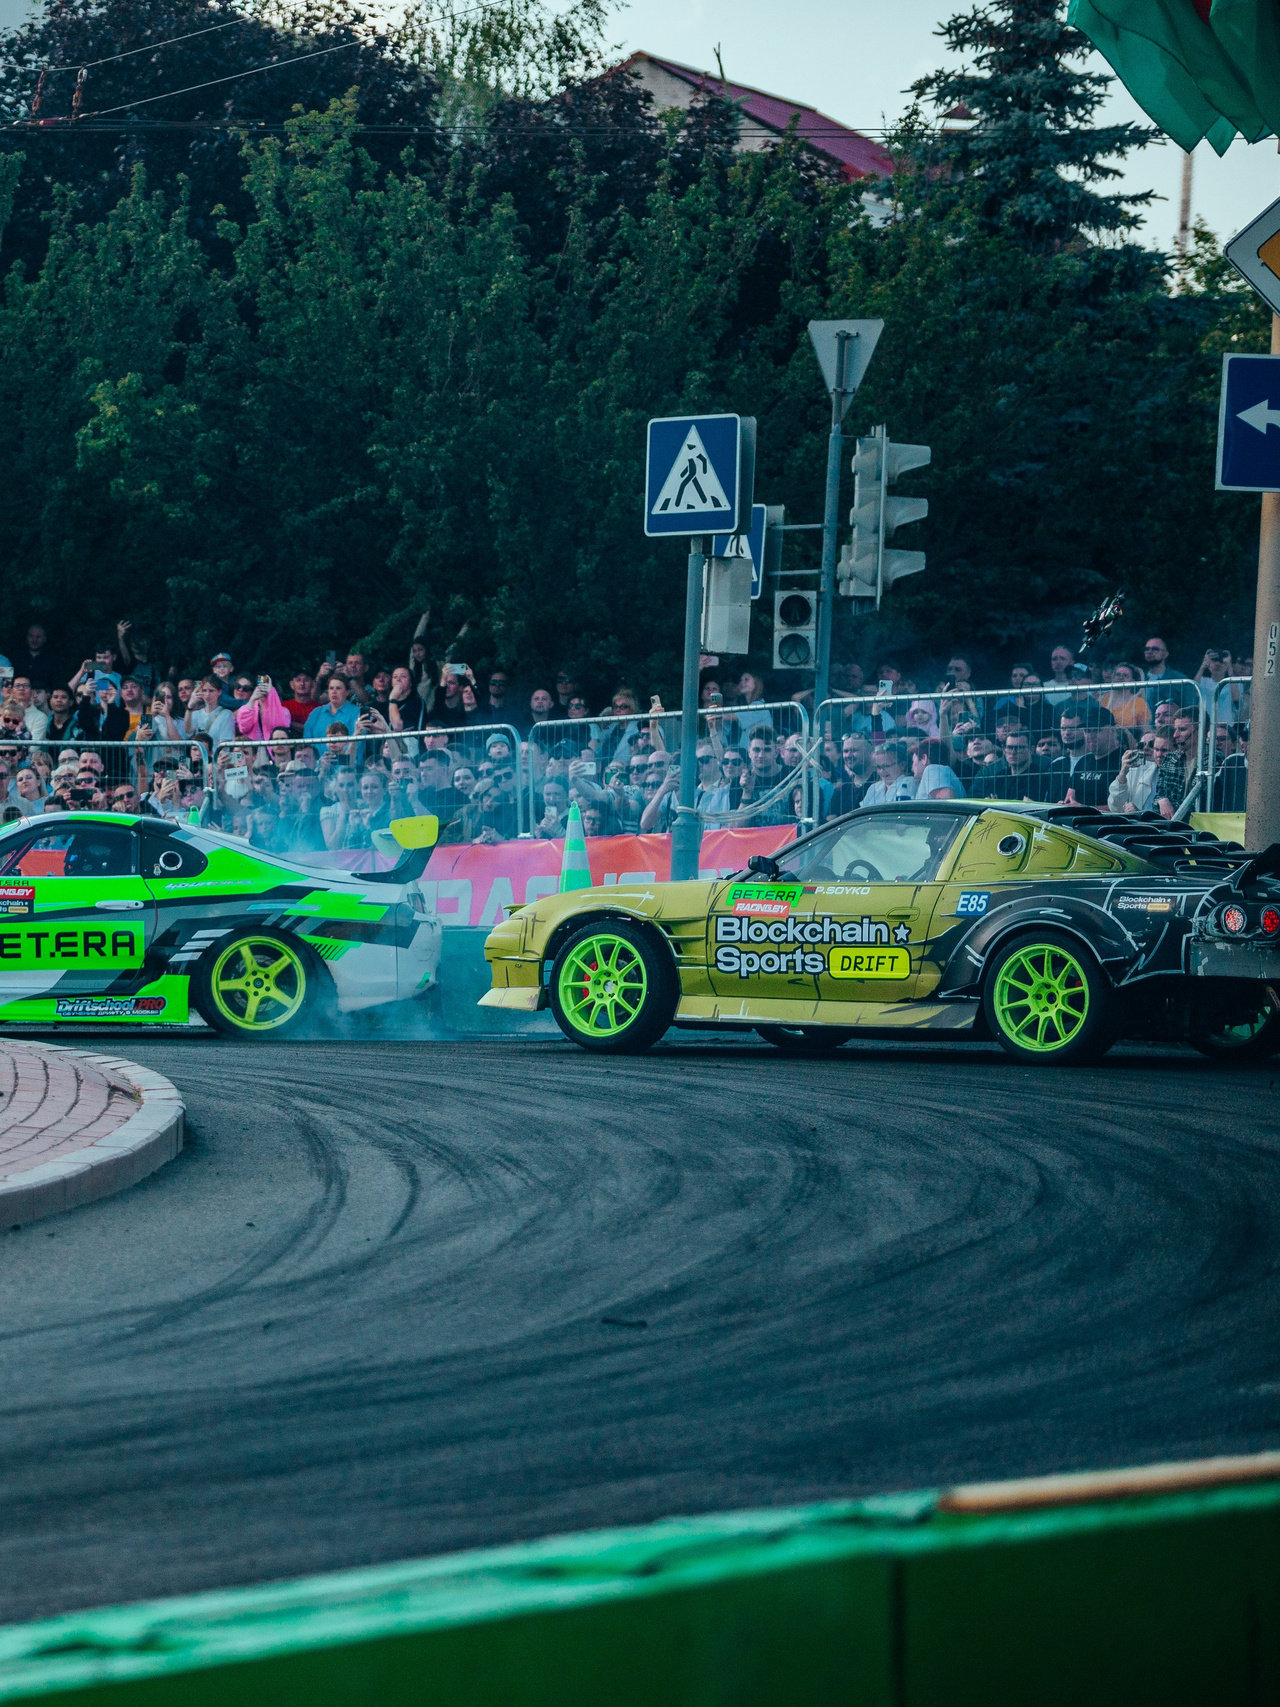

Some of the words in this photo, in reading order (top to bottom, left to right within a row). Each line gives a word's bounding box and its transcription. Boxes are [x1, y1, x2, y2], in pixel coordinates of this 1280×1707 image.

[1266, 624, 1278, 674] 052
[735, 902, 788, 914] RACING.BY
[956, 894, 988, 913] E85
[716, 916, 889, 943] Blockchain
[716, 946, 825, 977] Sports
[840, 955, 899, 972] DRIFT
